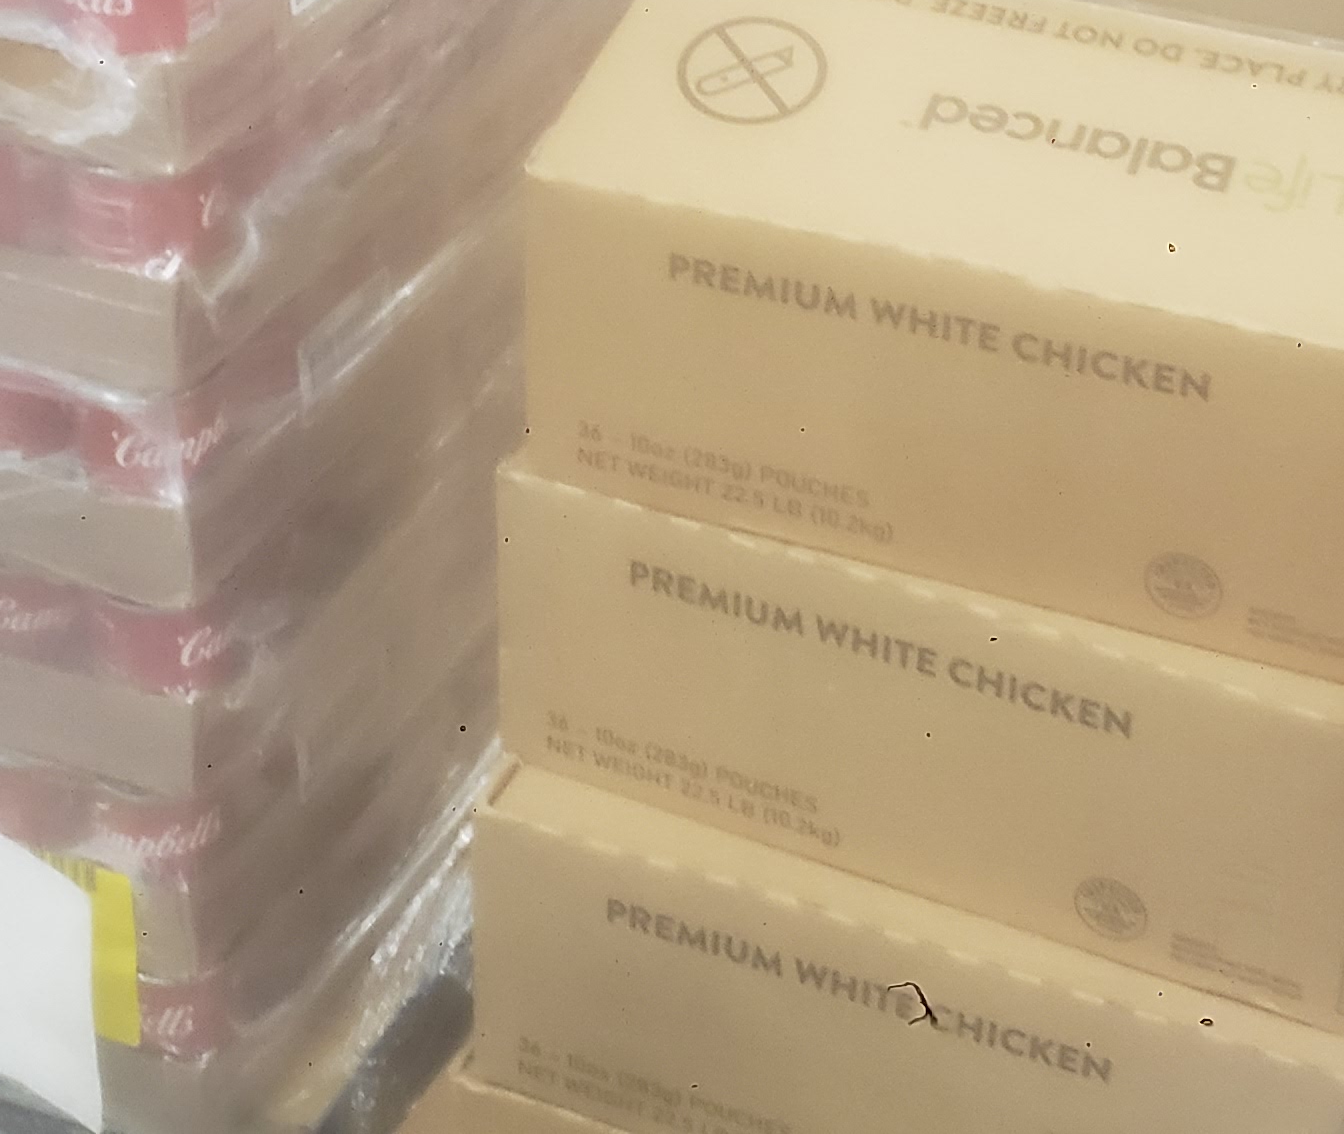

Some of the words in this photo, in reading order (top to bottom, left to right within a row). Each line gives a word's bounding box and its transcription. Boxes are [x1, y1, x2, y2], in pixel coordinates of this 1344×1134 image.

[1057, 18, 1123, 51] NOT
[1133, 36, 1182, 63] DO
[918, 92, 1238, 195] Balanced
[666, 251, 859, 321] PREMIUM
[869, 297, 1001, 354] WHITE
[1010, 331, 1214, 403] CHICKEN
[576, 446, 620, 473] NET
[627, 459, 716, 496] WEIGHT
[771, 495, 804, 518] LB
[759, 464, 870, 509] POUCHES
[628, 560, 804, 638] PREMIUM
[815, 614, 938, 678] WHITE
[947, 658, 1133, 740] CHICKEN
[546, 733, 586, 763] NET
[592, 750, 673, 790] WEIGHT
[727, 793, 755, 818] LB
[715, 764, 819, 814] POUCHES
[606, 897, 783, 978] PREMIUM
[793, 956, 916, 1020] WHITE
[925, 1003, 1114, 1083] CHICKEN
